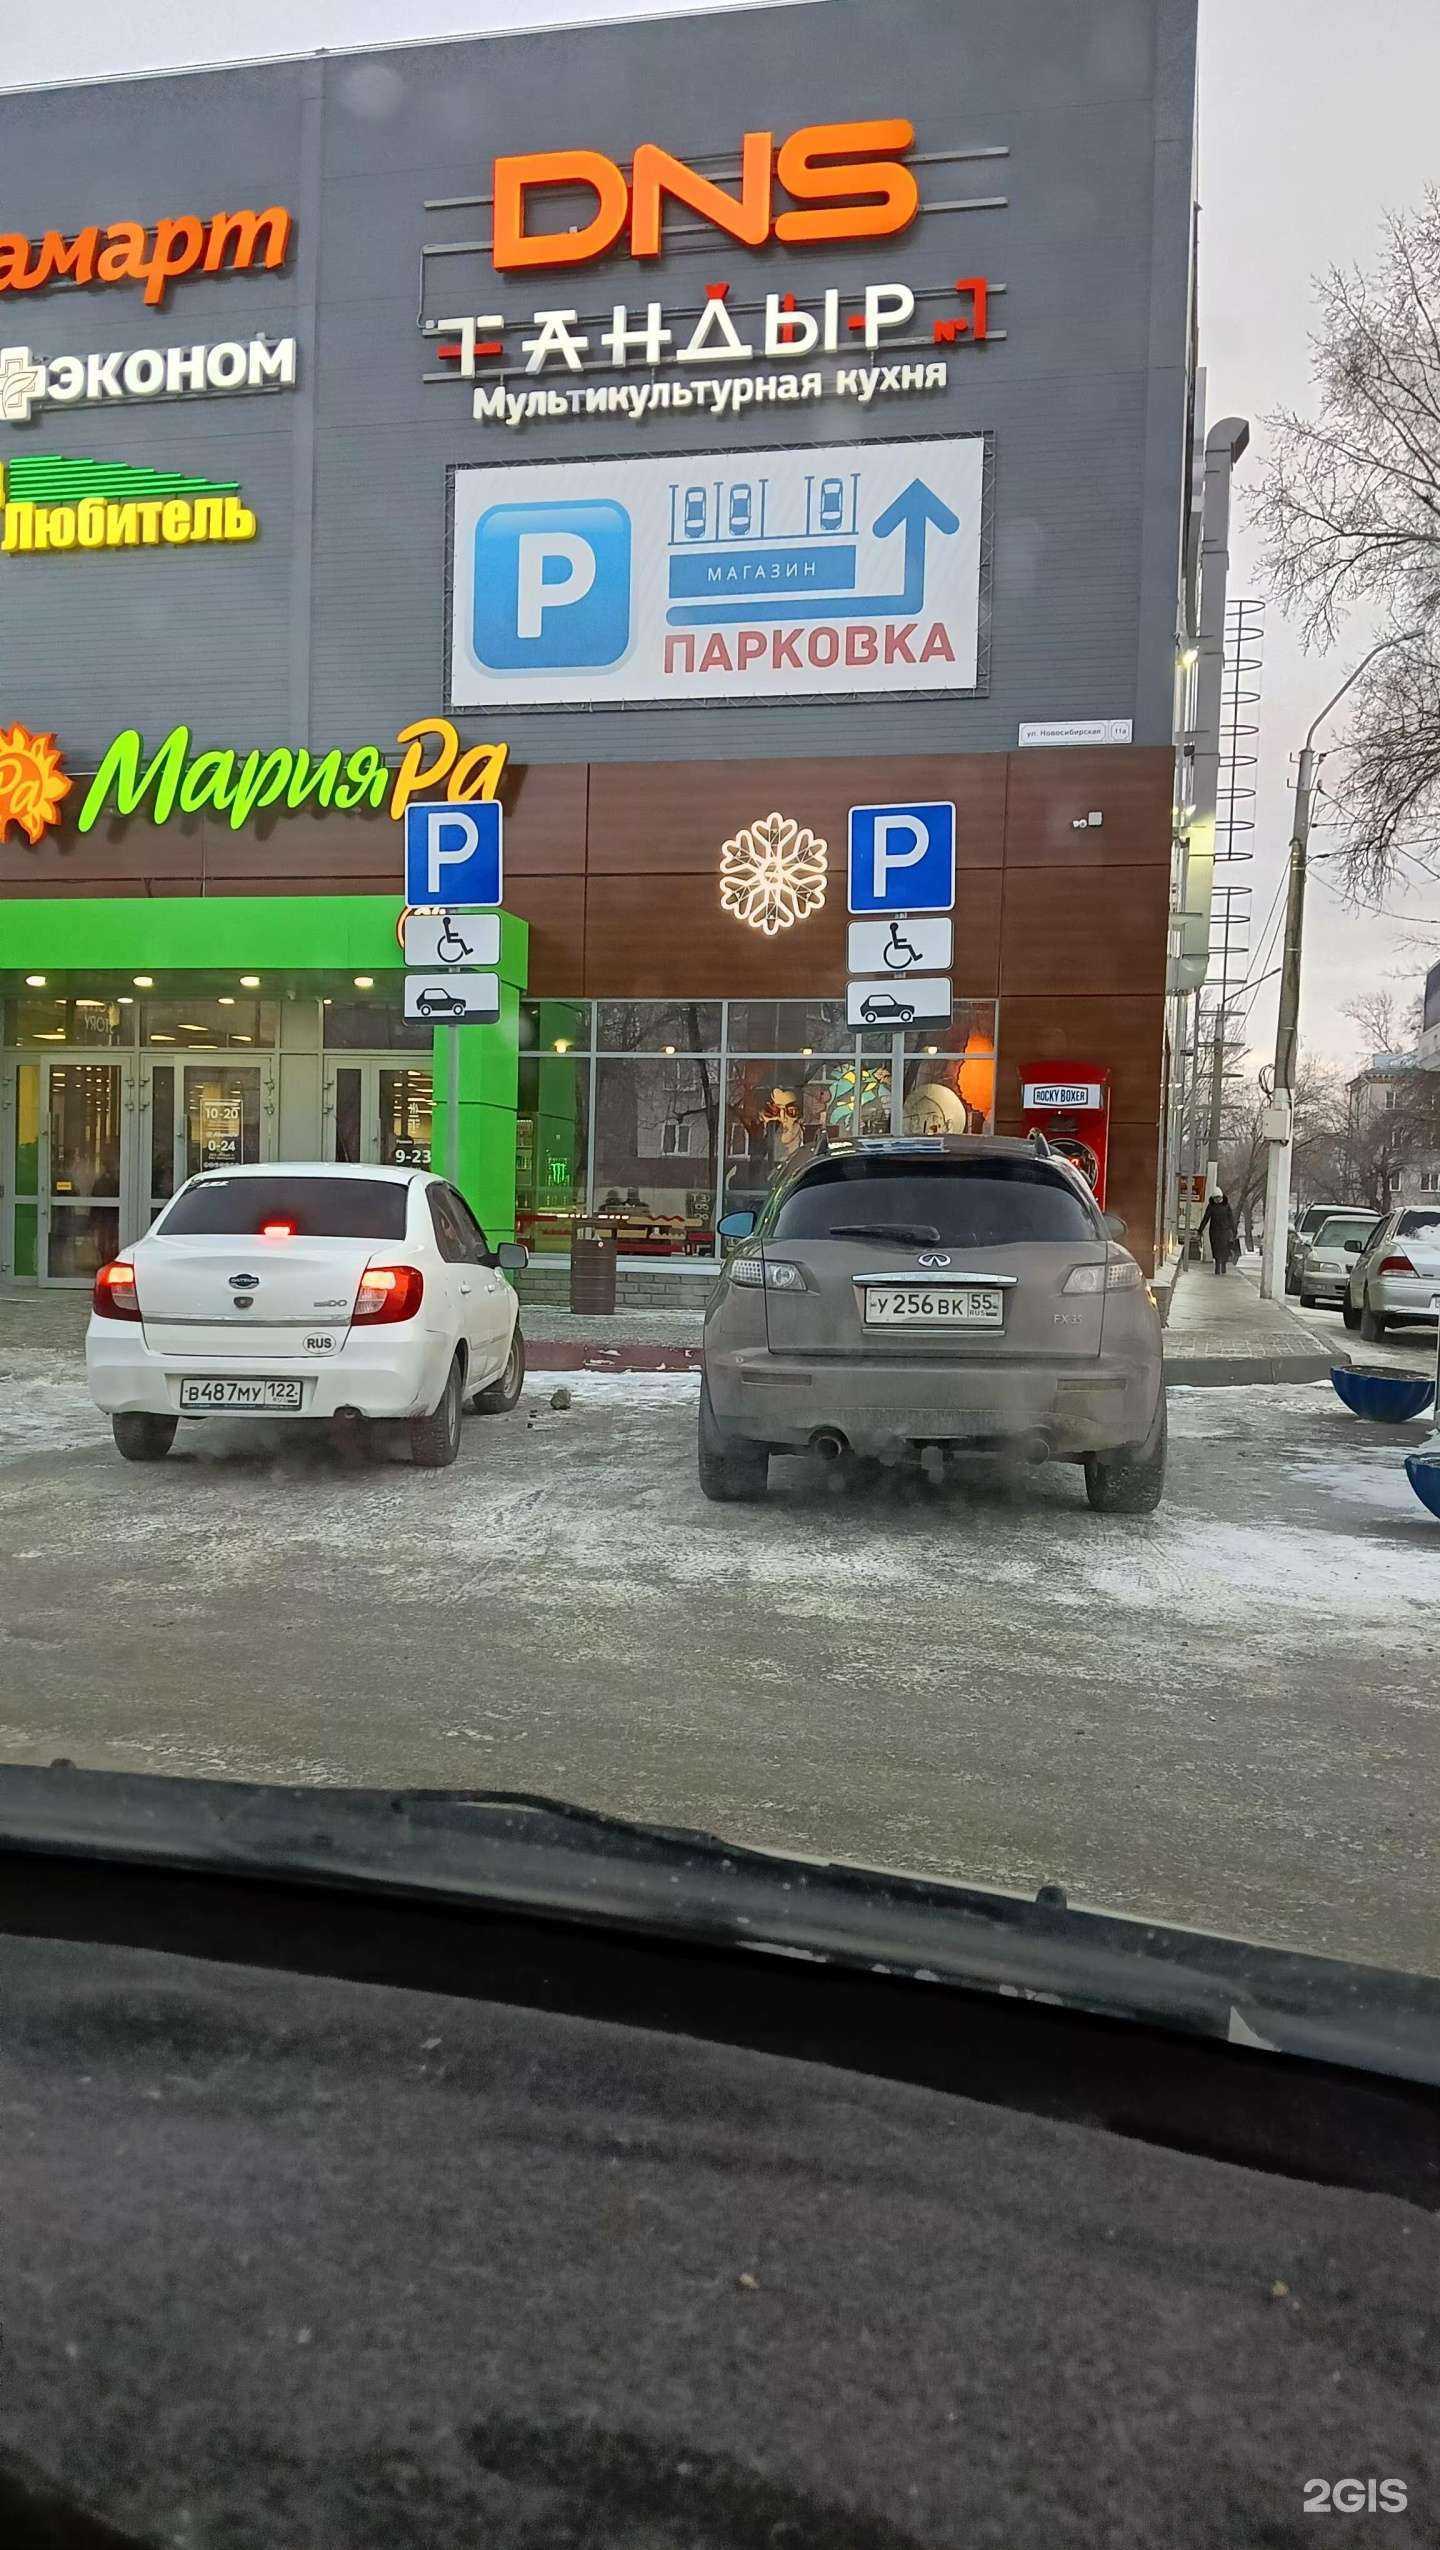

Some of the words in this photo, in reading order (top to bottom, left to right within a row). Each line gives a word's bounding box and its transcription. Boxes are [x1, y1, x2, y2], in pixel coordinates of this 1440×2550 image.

[493, 118, 919, 273] DNS
[0, 205, 293, 306] амарт
[436, 281, 916, 377] ТАНДЫР
[473, 372, 822, 426] Мультикультурная
[837, 361, 948, 402] кухня
[1, 496, 257, 551] Любитель
[516, 532, 597, 639] P
[707, 561, 818, 583] МАГАЗИН
[663, 622, 957, 674] ПАРКОВКА
[1040, 728, 1101, 737] Новосибирская
[426, 812, 480, 894] P
[873, 814, 930, 898] P
[205, 1107, 239, 1119] 10-20
[1036, 1089, 1059, 1102] ROCKY
[1060, 1089, 1085, 1102] BOXER
[208, 1140, 236, 1151] 0-24
[395, 1149, 432, 1163] 9-23
[971, 1294, 993, 1310] 55
[306, 1337, 332, 1349] RUS
[267, 1383, 296, 1398] 122
